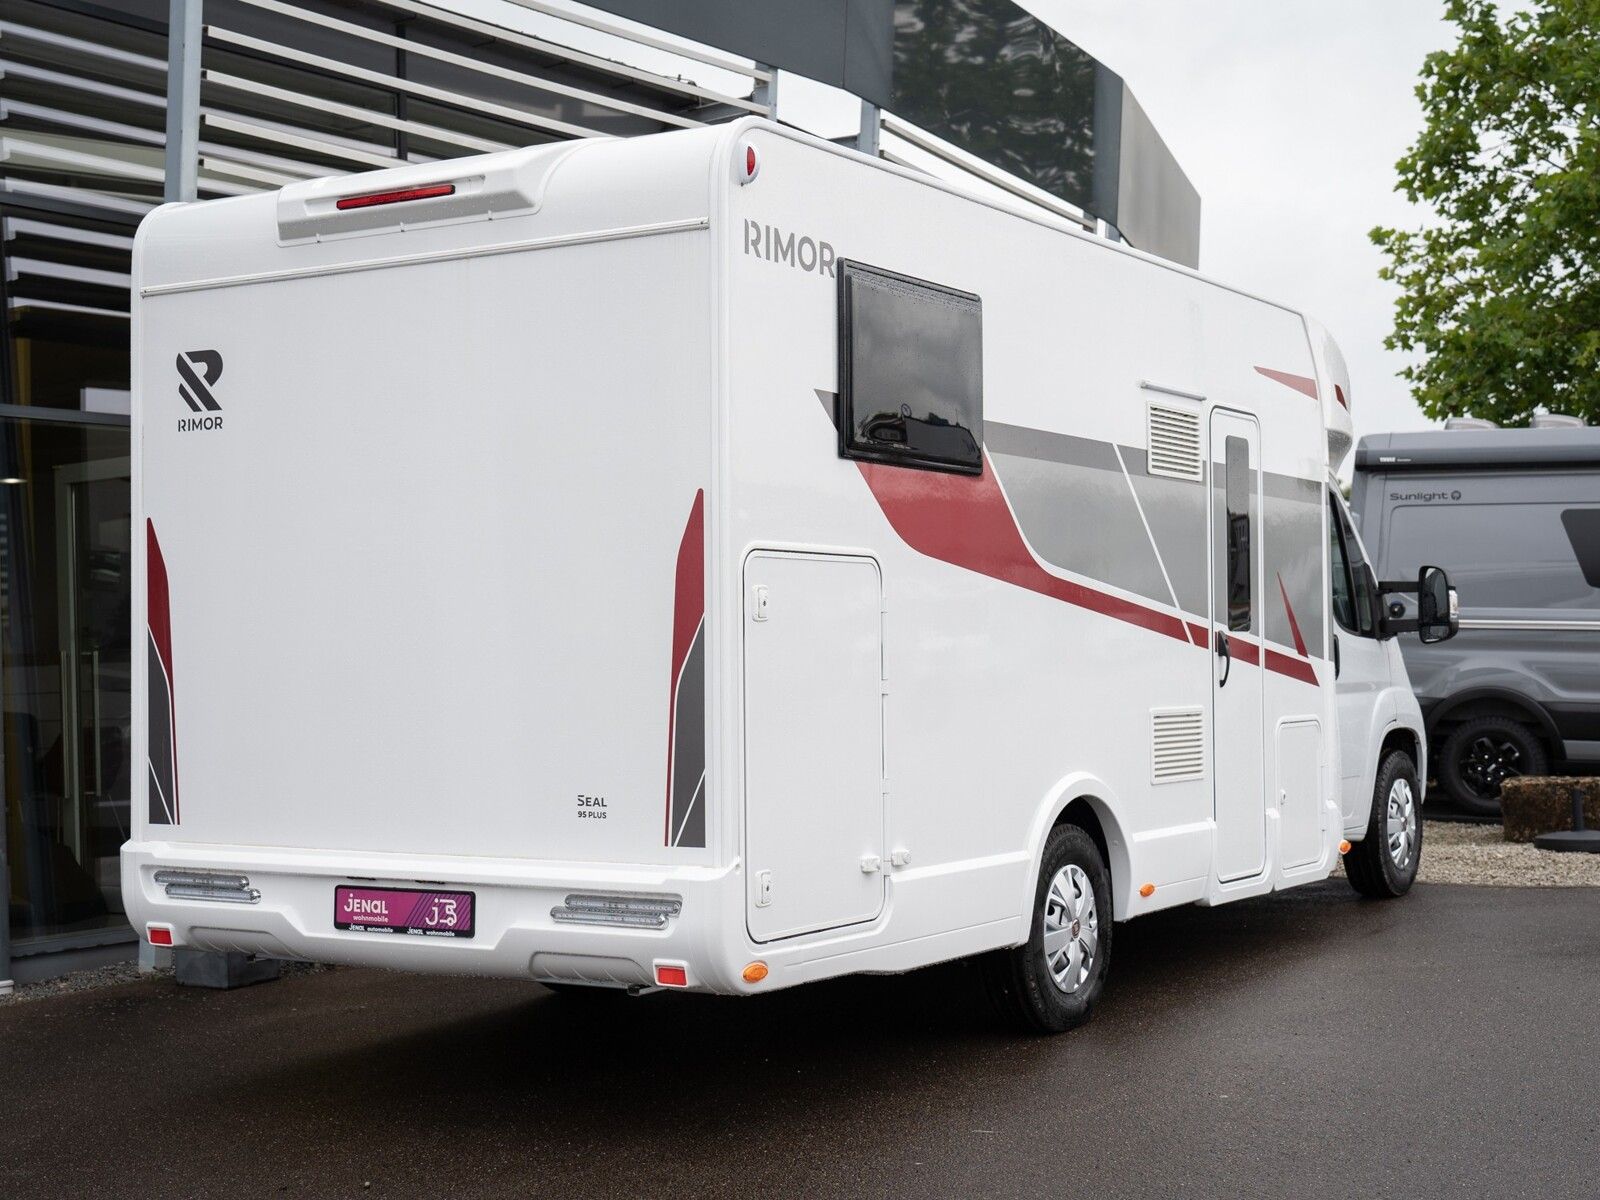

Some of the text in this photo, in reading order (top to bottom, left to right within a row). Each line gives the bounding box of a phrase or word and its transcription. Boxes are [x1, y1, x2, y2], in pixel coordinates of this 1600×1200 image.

[744, 218, 835, 279] RIMOR
[177, 416, 223, 432] RIMOR
[1389, 492, 1449, 502] Sunlight
[577, 795, 607, 807] SEAL
[577, 810, 607, 819] 95 PLUS
[352, 915, 389, 923] wohnmobile
